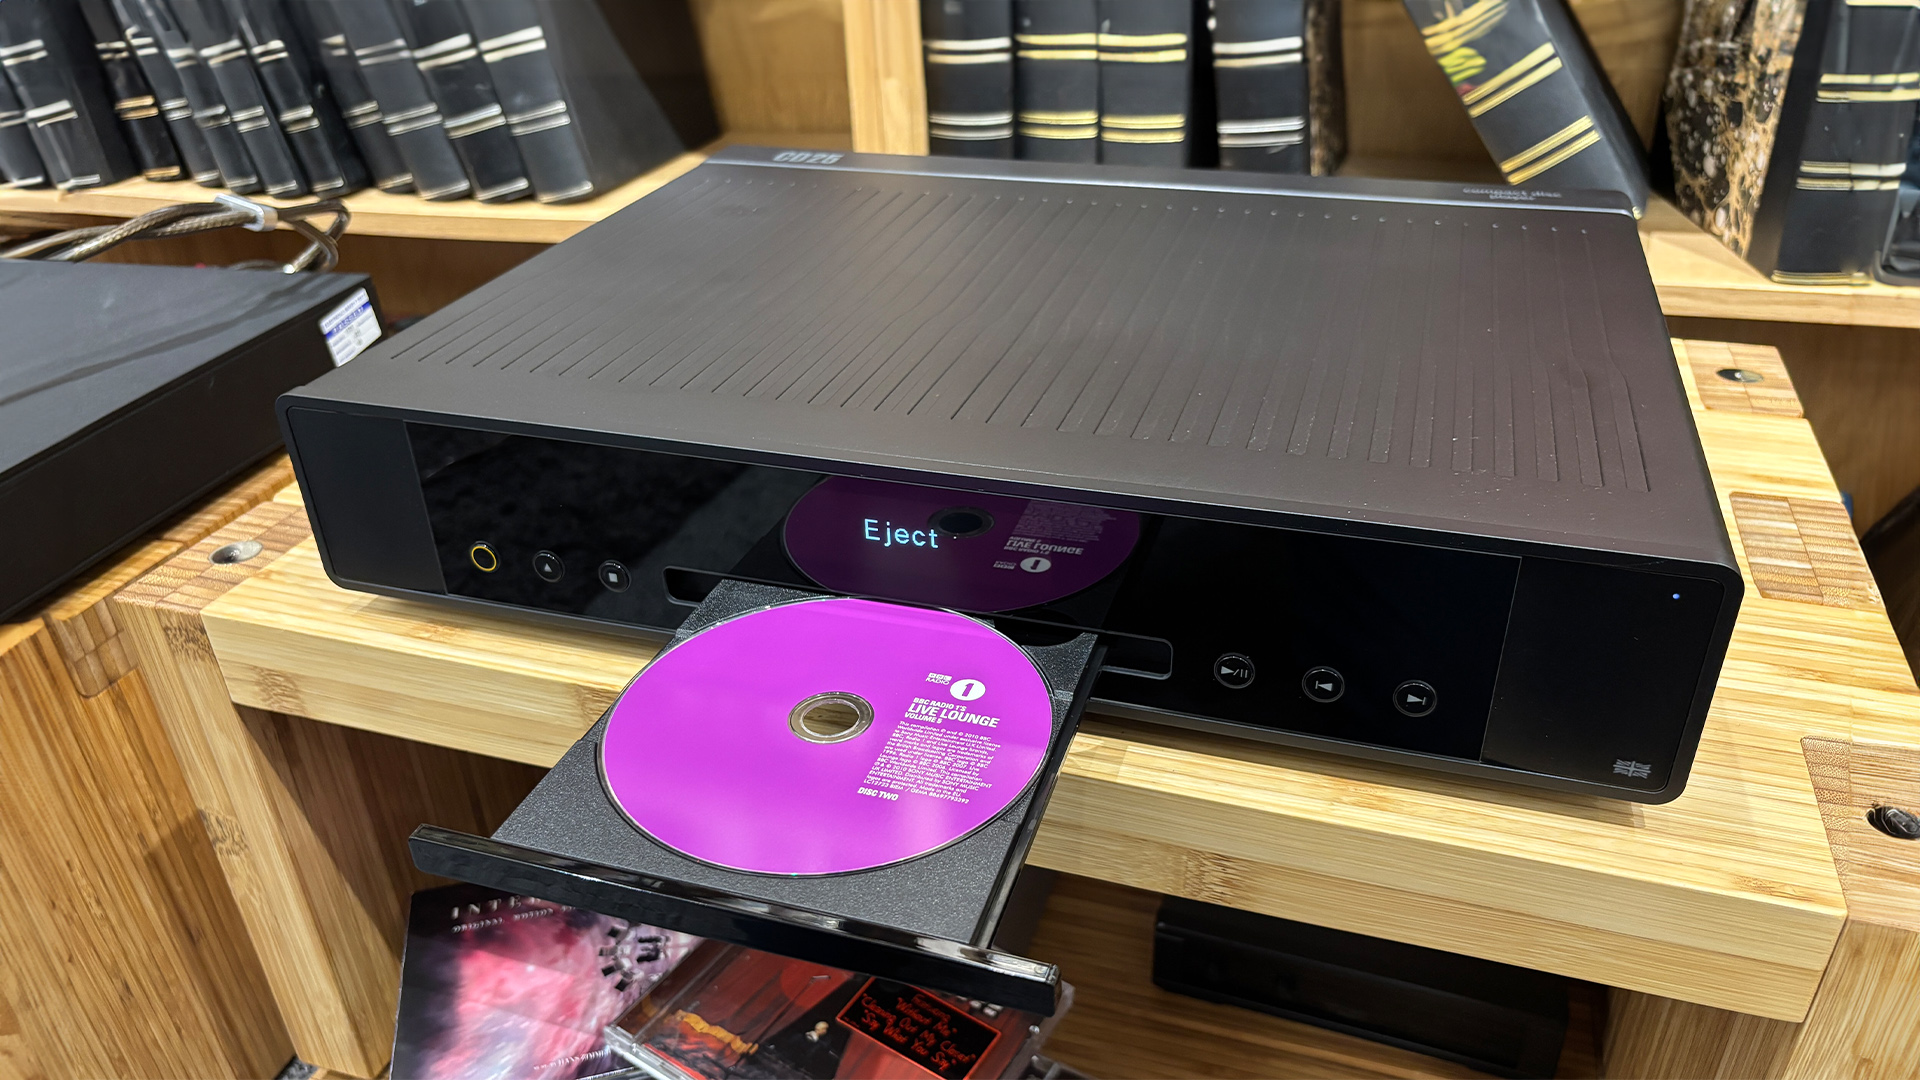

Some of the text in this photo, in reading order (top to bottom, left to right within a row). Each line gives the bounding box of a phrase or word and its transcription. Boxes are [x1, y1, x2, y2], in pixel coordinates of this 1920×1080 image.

[864, 518, 939, 549] Eject
[913, 697, 930, 705] BBC
[930, 700, 954, 709] RADIO
[905, 712, 937, 723] VOLUME
[908, 703, 999, 727] LIVE LOUNGE
[857, 787, 899, 801] DISC TWO
